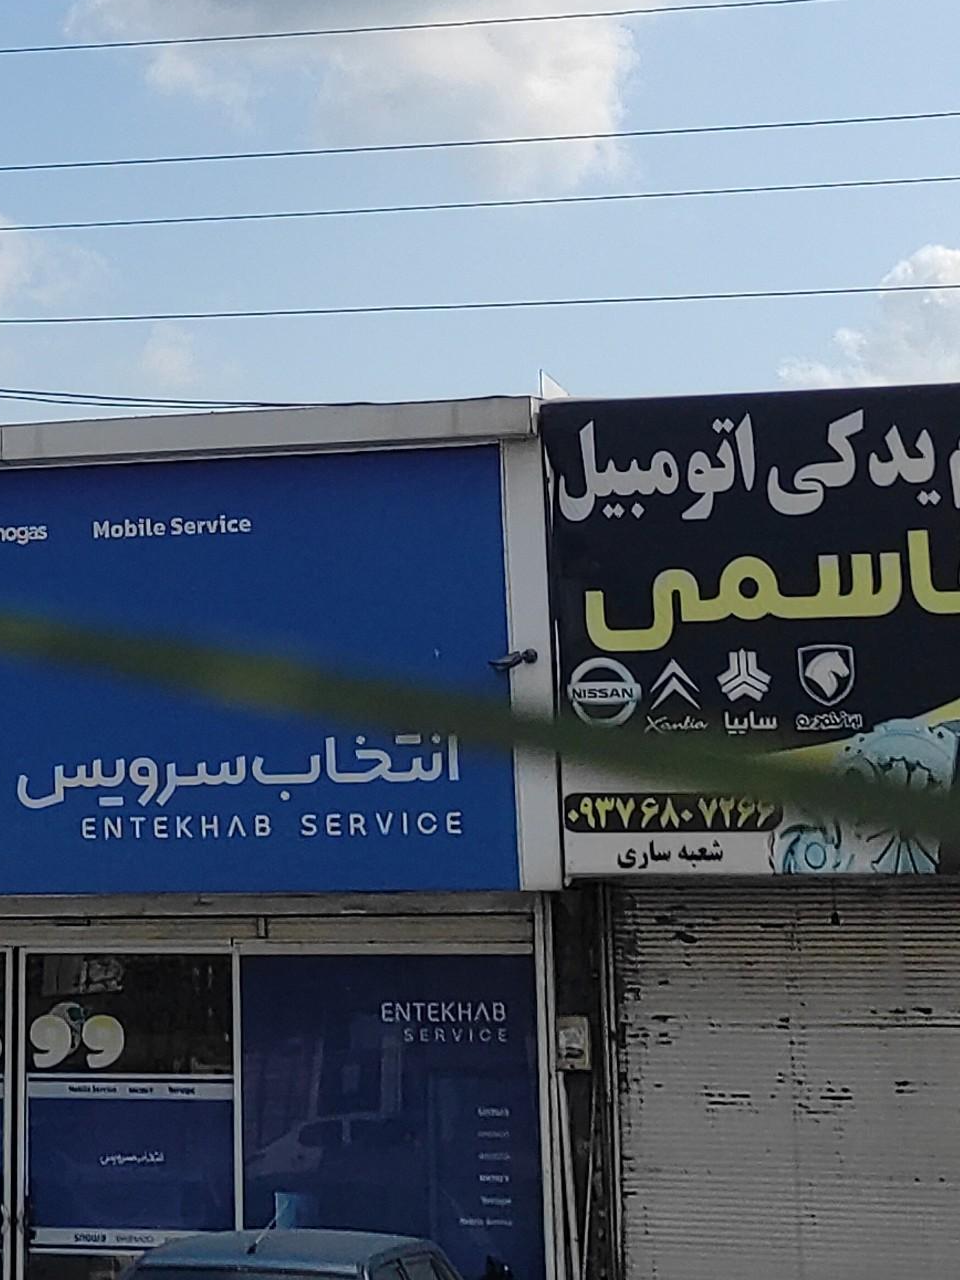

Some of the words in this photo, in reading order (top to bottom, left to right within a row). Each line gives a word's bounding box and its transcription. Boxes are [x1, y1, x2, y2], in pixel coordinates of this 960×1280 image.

[558, 412, 757, 522] اتومبیل
[767, 409, 942, 516] یدکی
[93, 518, 166, 540] Mobile
[170, 514, 252, 536] Service
[585, 529, 960, 652] اسمی
[572, 687, 634, 699] NISSAN
[251, 734, 461, 801] انتخاب
[16, 756, 247, 810] سرویس
[81, 814, 271, 841] ENTEKHAB
[300, 811, 464, 836] SERVICE
[617, 840, 672, 869] ساری
[678, 840, 724, 868] شعبه
[381, 1002, 506, 1022] ENTEKHAB
[404, 1028, 508, 1043] SERVICE
